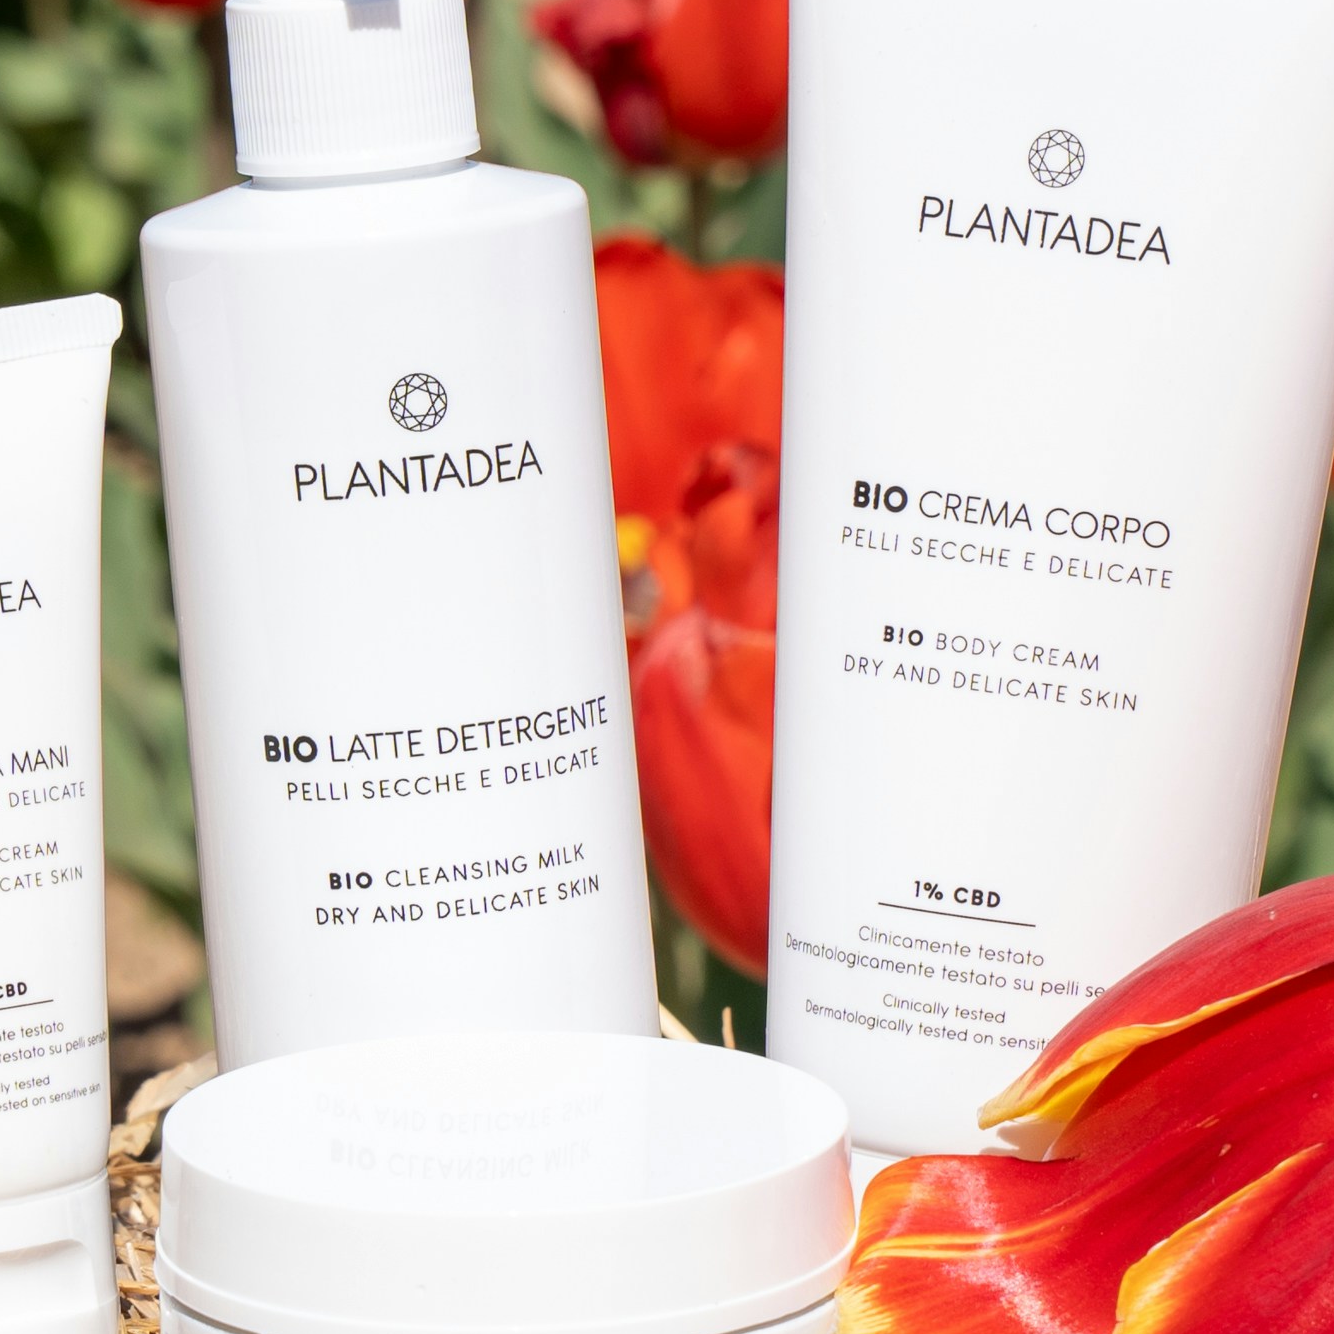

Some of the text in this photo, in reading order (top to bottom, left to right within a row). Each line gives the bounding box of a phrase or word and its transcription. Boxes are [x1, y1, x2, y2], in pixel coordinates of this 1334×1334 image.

[919, 196, 1170, 265] PLANTADEA
[294, 440, 542, 501] PLANTADEA
[853, 480, 1170, 548] BIO CREMA CORPO
[842, 526, 1173, 589] PELLI SECCHE E DELICATE
[883, 625, 1098, 671] BIO BODY CREAM
[844, 654, 1137, 711] DRY AND DELICATE SKIN
[264, 696, 607, 763] BIO LATTE DETERGENTE
[12, 745, 68, 774] MANI
[287, 747, 598, 801] PELLI SECCHE E DELICATE
[9, 781, 85, 808] DELICATE
[51, 866, 82, 884] SKIN
[329, 843, 584, 890] BIO CLEANSING MILK
[316, 875, 599, 925] DRY AND DELICATE SKIN
[915, 881, 1000, 908] 1% CBD
[786, 932, 934, 978] Dermatologicamente
[942, 965, 1006, 988] testato
[1013, 978, 1034, 991] su
[1041, 981, 1078, 996] pelli
[859, 926, 1044, 966] Clinicamente testato
[21, 1021, 64, 1038] testato
[806, 997, 913, 1035] Dermatologically
[919, 1023, 968, 1041] tested
[973, 1033, 993, 1045] on
[883, 994, 1005, 1023] Clinically tested
[49, 1044, 62, 1055] su
[65, 1037, 85, 1054] pelli
[15, 1075, 50, 1090] tested
[32, 1096, 46, 1106] on
[49, 1087, 87, 1103] sensitive
